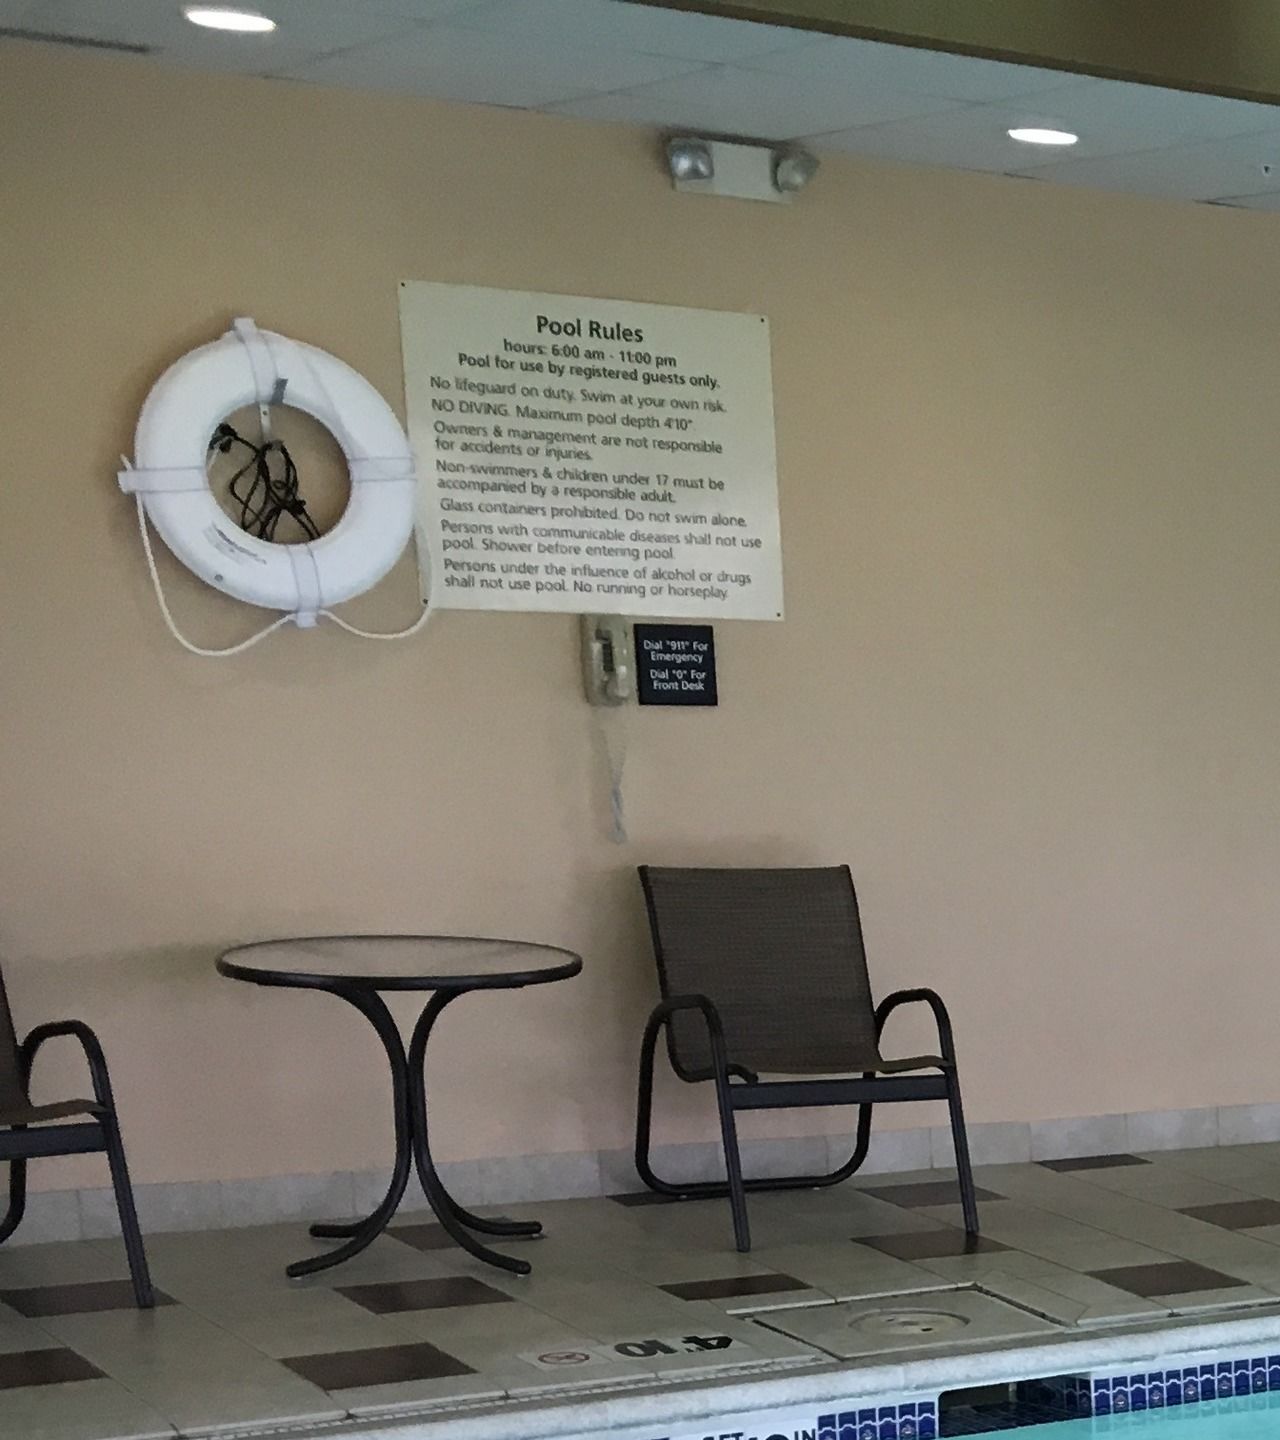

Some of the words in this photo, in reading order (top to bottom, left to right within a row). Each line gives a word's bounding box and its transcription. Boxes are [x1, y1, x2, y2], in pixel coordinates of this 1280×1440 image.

[536, 314, 582, 338] Pool
[587, 319, 643, 343] Rules
[503, 338, 547, 355] hours:
[551, 342, 579, 358] 6:00
[583, 349, 604, 361] am
[619, 349, 652, 365] 11:00
[654, 355, 676, 369] pm
[458, 352, 490, 368] Pool
[494, 355, 515, 370] for
[519, 360, 544, 373] use
[547, 360, 566, 377] by
[569, 362, 638, 383] registered
[641, 370, 686, 387] guests
[688, 372, 720, 390] only.
[429, 375, 451, 390] No
[455, 377, 516, 397] lifeguard
[520, 385, 539, 398] on
[580, 388, 615, 404] Swim
[619, 393, 633, 405] at
[637, 396, 666, 409] your
[670, 398, 699, 410] own
[703, 398, 726, 413] risk.
[431, 397, 455, 412] NO
[515, 404, 582, 422] Maximum
[586, 410, 617, 426] pool
[620, 413, 660, 429] depth
[433, 420, 488, 437] Owners
[492, 424, 503, 438] &
[507, 427, 597, 446] management
[600, 435, 621, 446] are
[625, 435, 648, 448] not
[652, 436, 722, 455] responsible
[434, 437, 455, 450] for
[459, 438, 522, 455] accidents
[526, 445, 540, 457] or
[545, 444, 592, 461] injuries.
[435, 459, 537, 478] Non-swimmers
[541, 466, 552, 479] &
[556, 467, 608, 483] children
[612, 471, 650, 486] under
[656, 473, 669, 485] 17
[672, 476, 704, 489] must
[708, 477, 724, 491] be
[436, 475, 526, 495] accompanied
[530, 481, 547, 496] by
[550, 485, 559, 496] a
[563, 483, 635, 501] responsible
[640, 488, 676, 503] adult.
[439, 497, 474, 512] Glass
[477, 501, 546, 516] containers
[550, 504, 620, 521] prohibited.
[624, 508, 644, 521] Do
[648, 510, 670, 523] not
[674, 513, 707, 524] swim
[710, 513, 746, 527] alone.
[440, 518, 494, 535] Persons
[497, 522, 528, 536] with
[531, 523, 625, 541] communicable
[628, 529, 680, 544] diseases
[683, 532, 711, 545] shall
[715, 535, 736, 546] not
[741, 537, 762, 548] use
[442, 535, 476, 551] pool.
[481, 538, 533, 553] Shower
[536, 540, 581, 555] before
[585, 544, 640, 559] entering
[443, 558, 496, 572] Persons
[500, 561, 539, 575] under
[543, 562, 566, 576] the
[570, 563, 629, 578] influence
[632, 566, 647, 579] of
[650, 567, 695, 581] alcohol
[699, 572, 712, 582] or
[716, 570, 751, 587] drugs
[444, 574, 475, 588] shall
[479, 577, 503, 589] not
[508, 579, 531, 590] use
[535, 578, 568, 595] pool.
[573, 580, 593, 592] No
[596, 583, 646, 598] running
[649, 585, 664, 595] or
[643, 639, 663, 650] Dial
[666, 640, 691, 652] "911"
[692, 642, 709, 652] For
[650, 651, 704, 664] Emergency
[649, 669, 669, 680] Dial
[690, 670, 706, 680] For
[653, 680, 679, 691] Front
[681, 681, 705, 691] Desk
